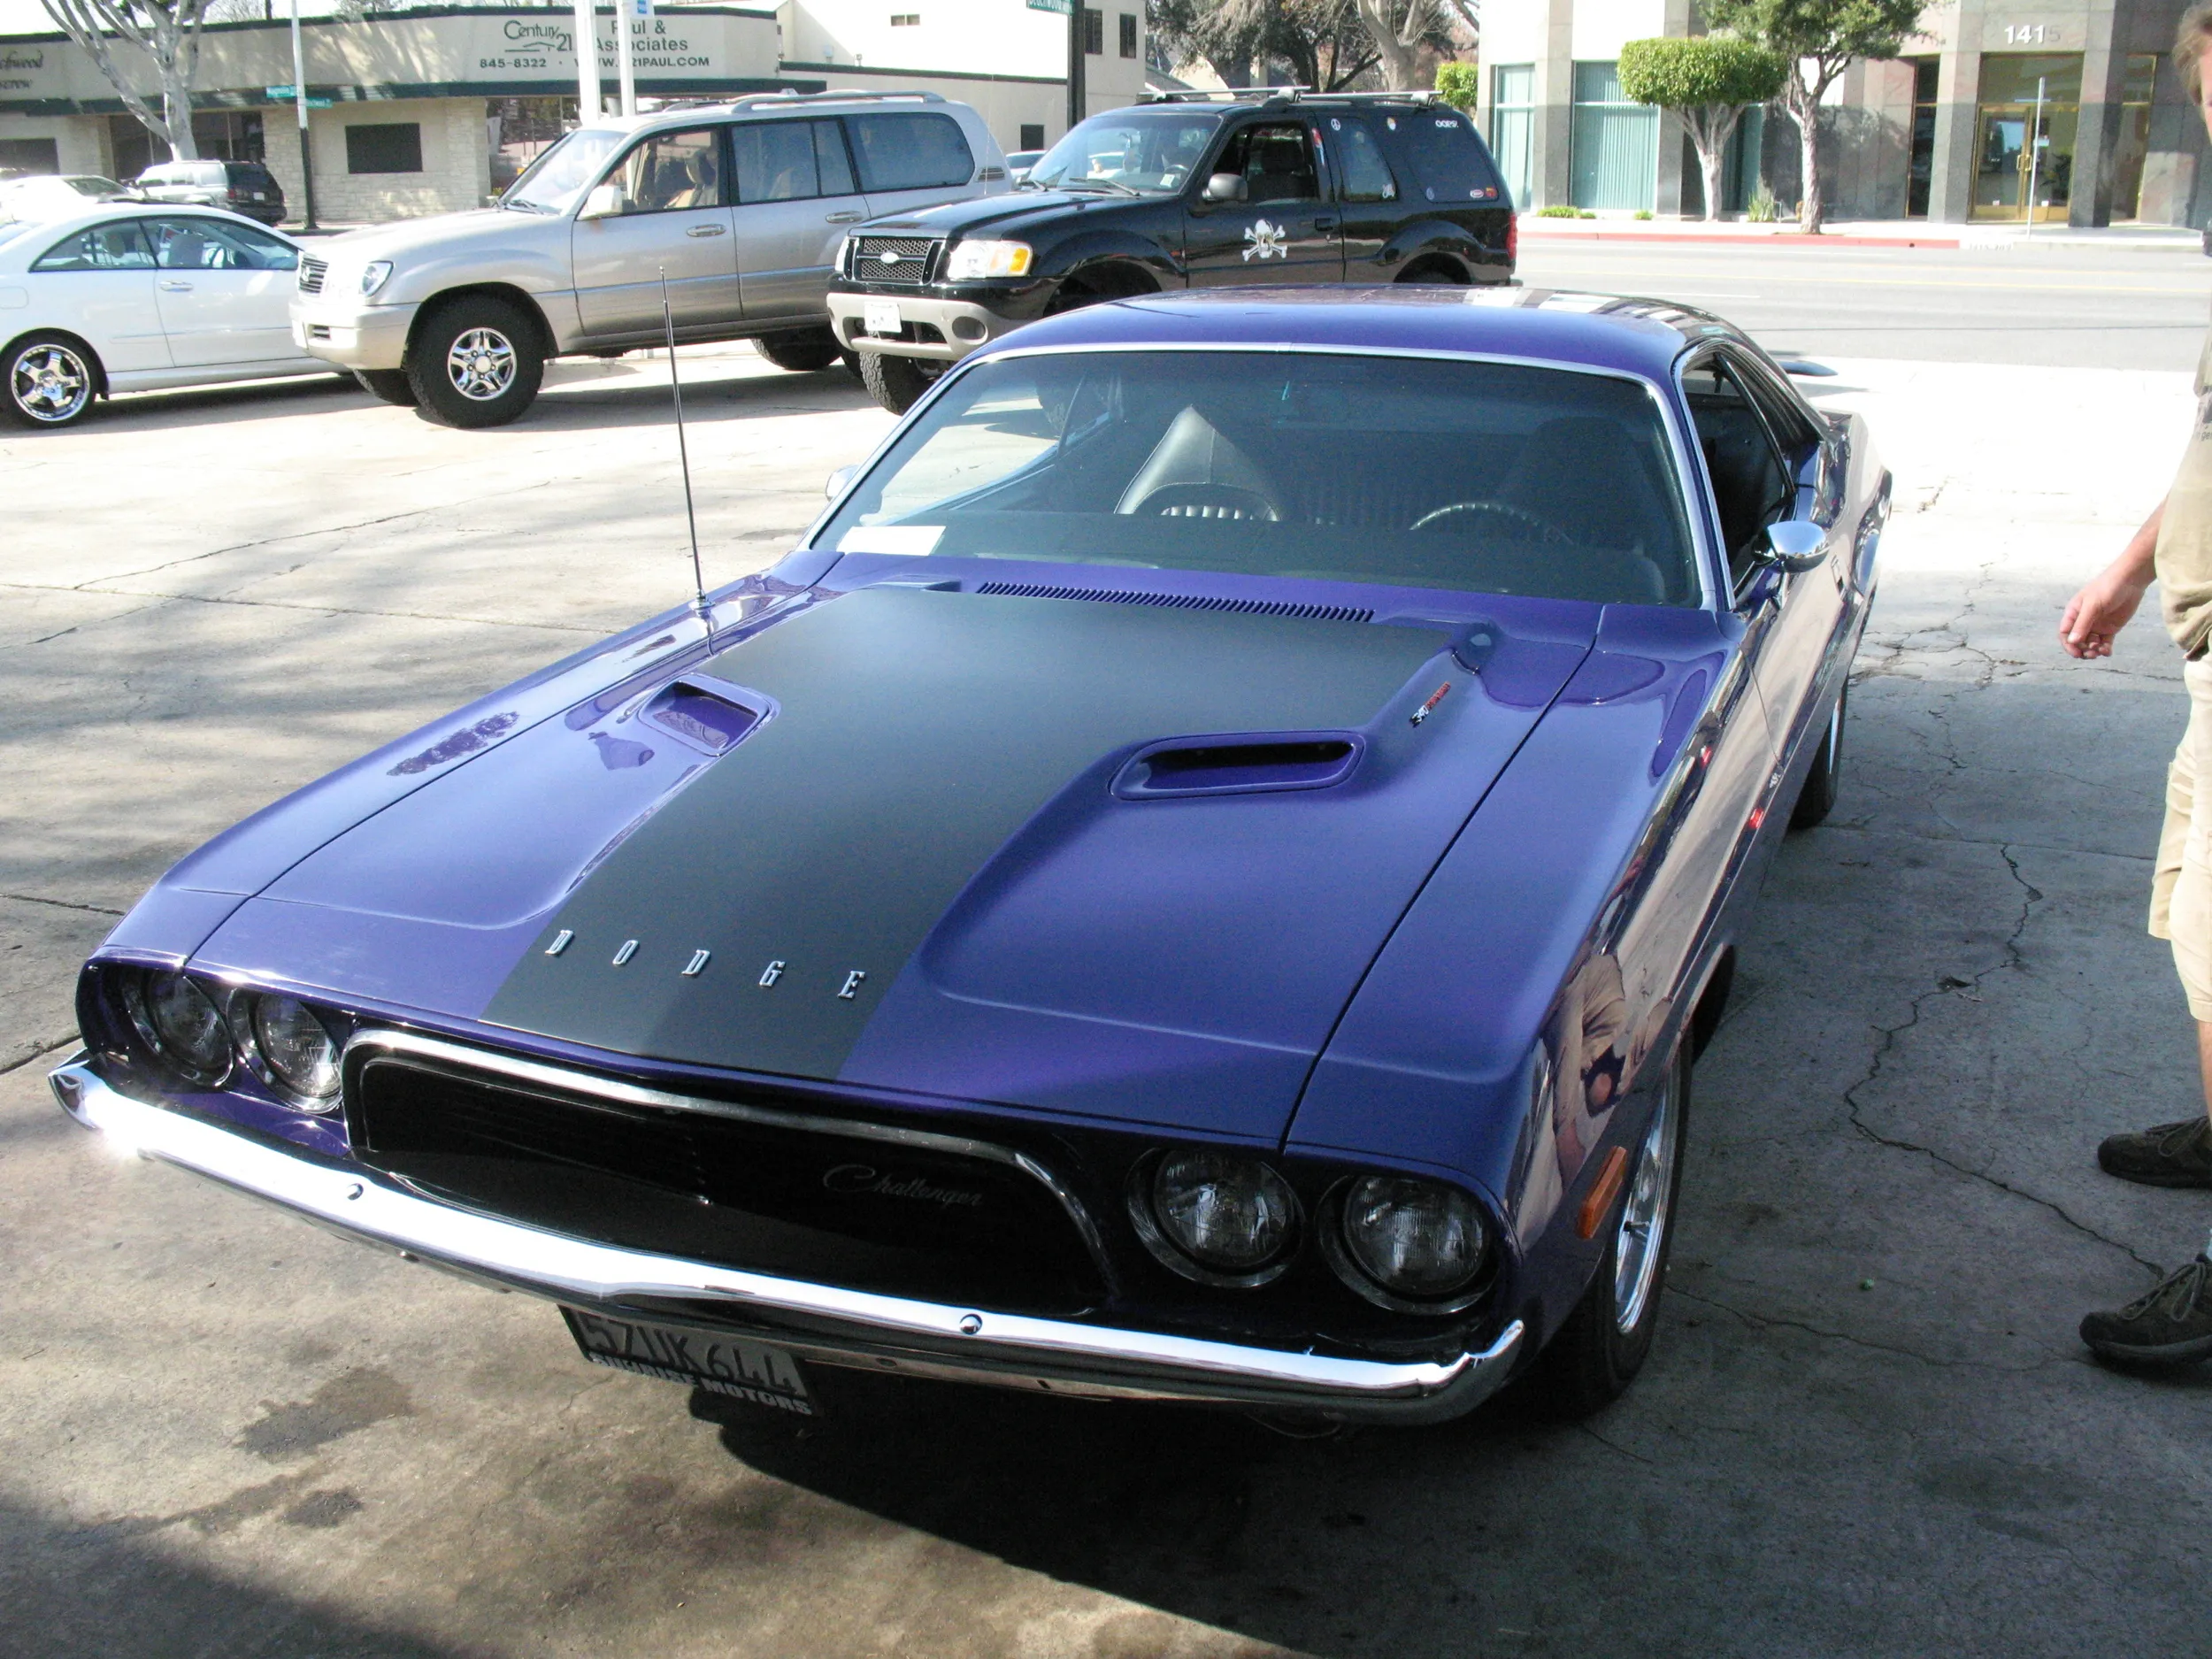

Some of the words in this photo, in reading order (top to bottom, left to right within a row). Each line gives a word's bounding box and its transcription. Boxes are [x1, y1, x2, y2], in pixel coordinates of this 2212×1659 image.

[503, 19, 560, 40] Century
[556, 34, 573, 51] 21
[611, 19, 646, 35] Pul
[655, 19, 666, 35] &
[480, 58, 547, 68] 845-8322
[574, 57, 710, 68] W.21PAUL.COM
[544, 929, 866, 1000] DODGE
[823, 1164, 983, 1209] Challenger
[701, 1377, 813, 1416] MOTORS
